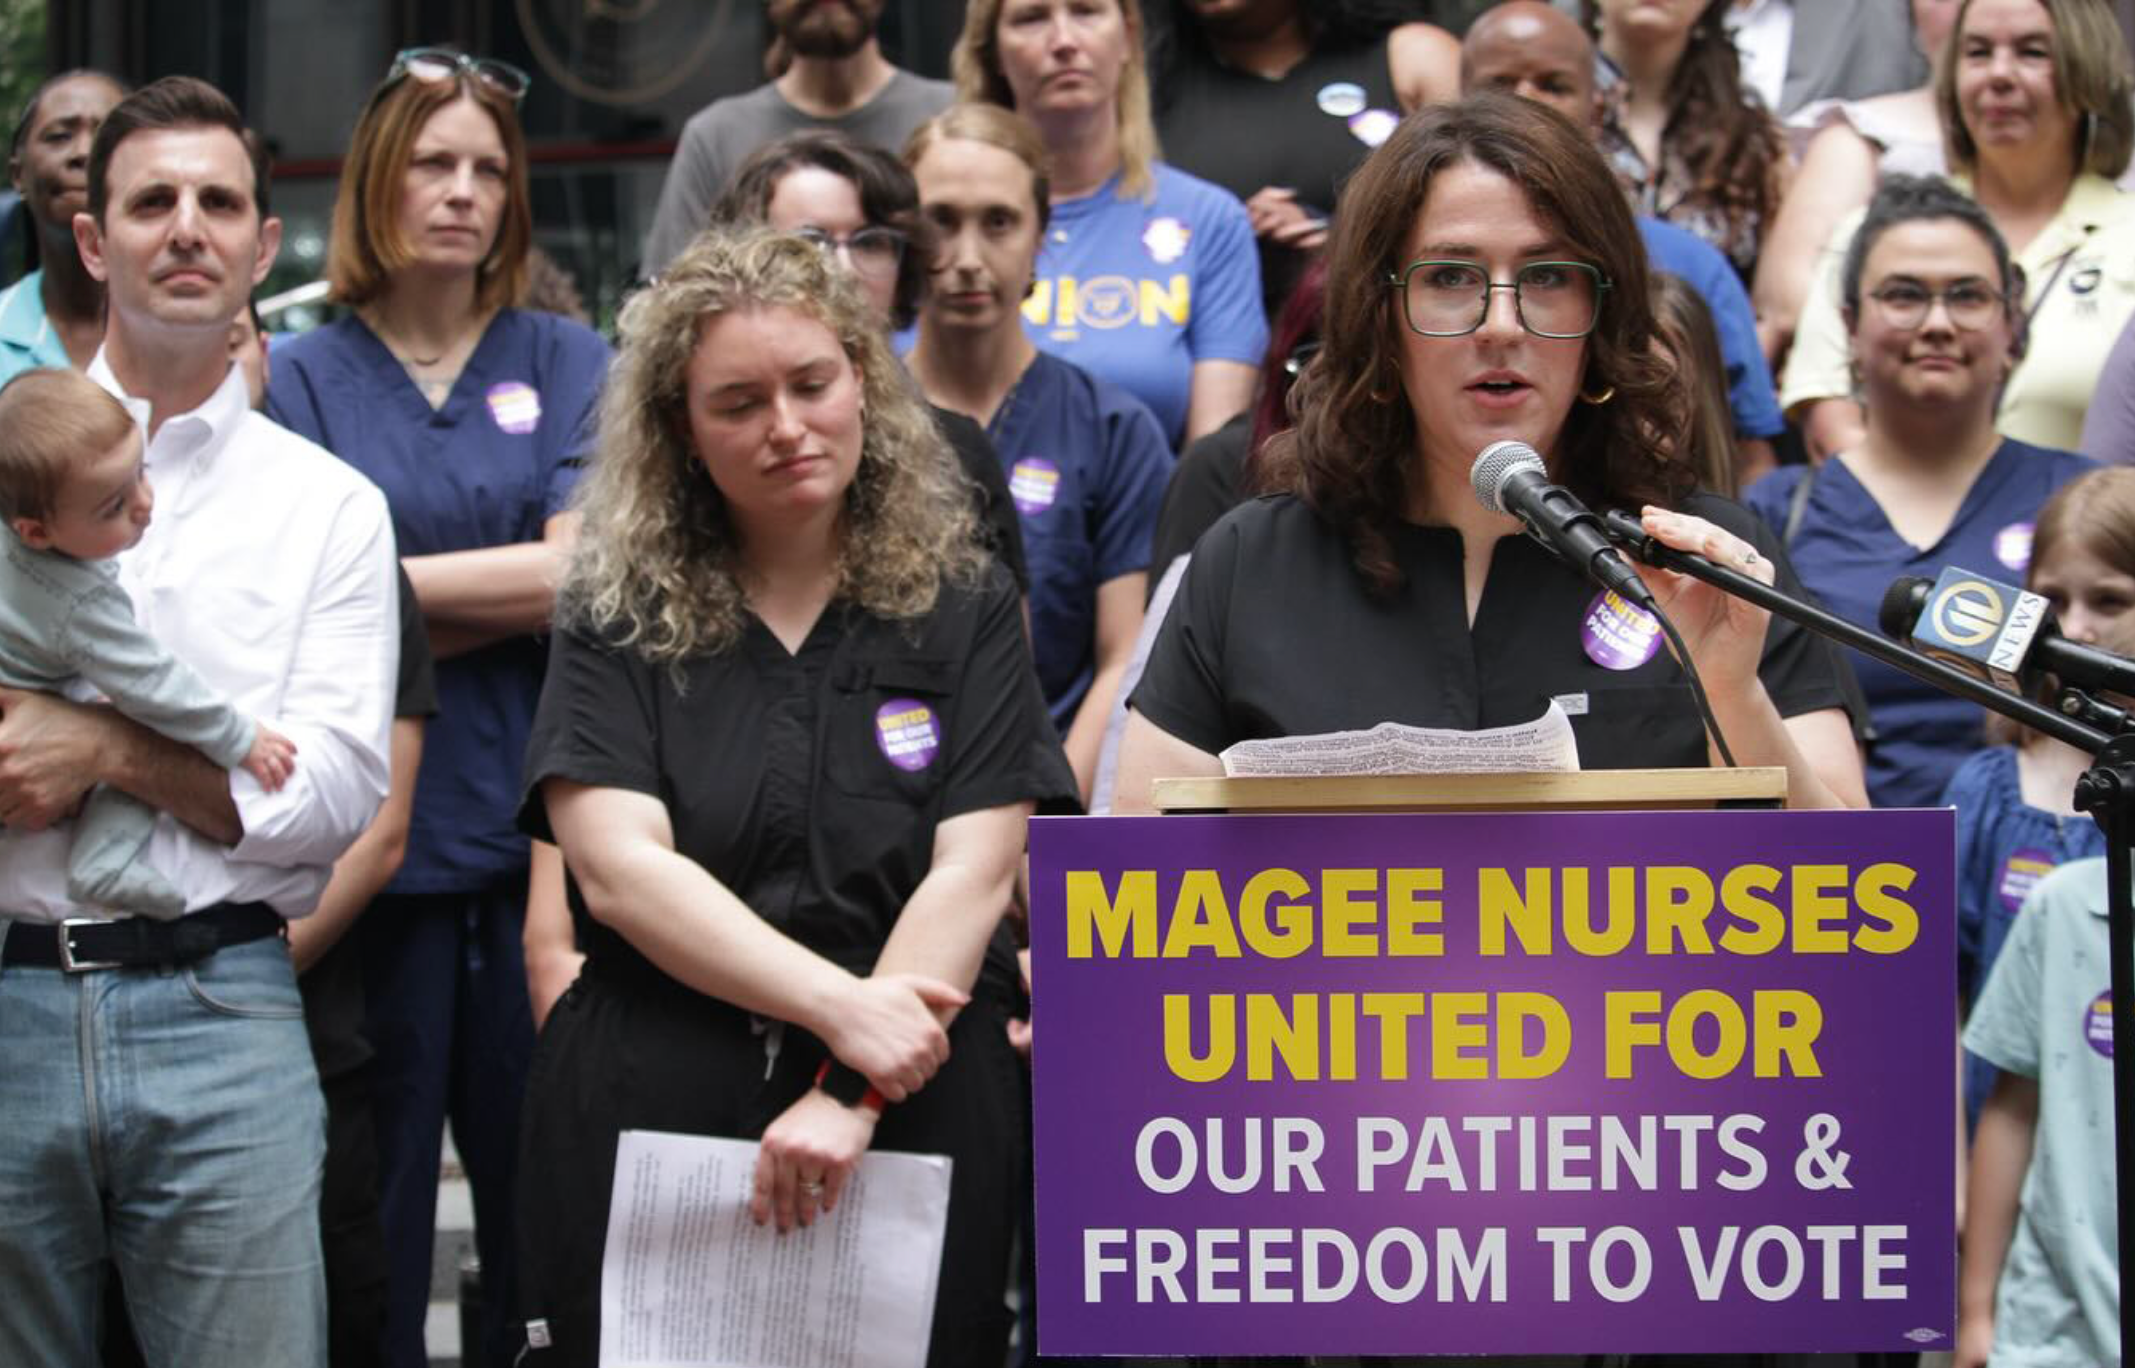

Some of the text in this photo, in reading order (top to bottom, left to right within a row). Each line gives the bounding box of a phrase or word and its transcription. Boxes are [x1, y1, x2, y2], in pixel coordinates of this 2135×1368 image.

[1020, 274, 1191, 328] NION
[1586, 613, 1649, 661] PATIE
[1595, 603, 1621, 632] FOR
[1993, 596, 2041, 668] NEWS
[1066, 862, 1919, 959] MAGEE NURSES
[1163, 989, 1823, 1083] UNITED FOR
[1135, 1113, 1853, 1194] OUR PATIENTS &
[1083, 1224, 1908, 1304] FREEDOM TO VOTE
